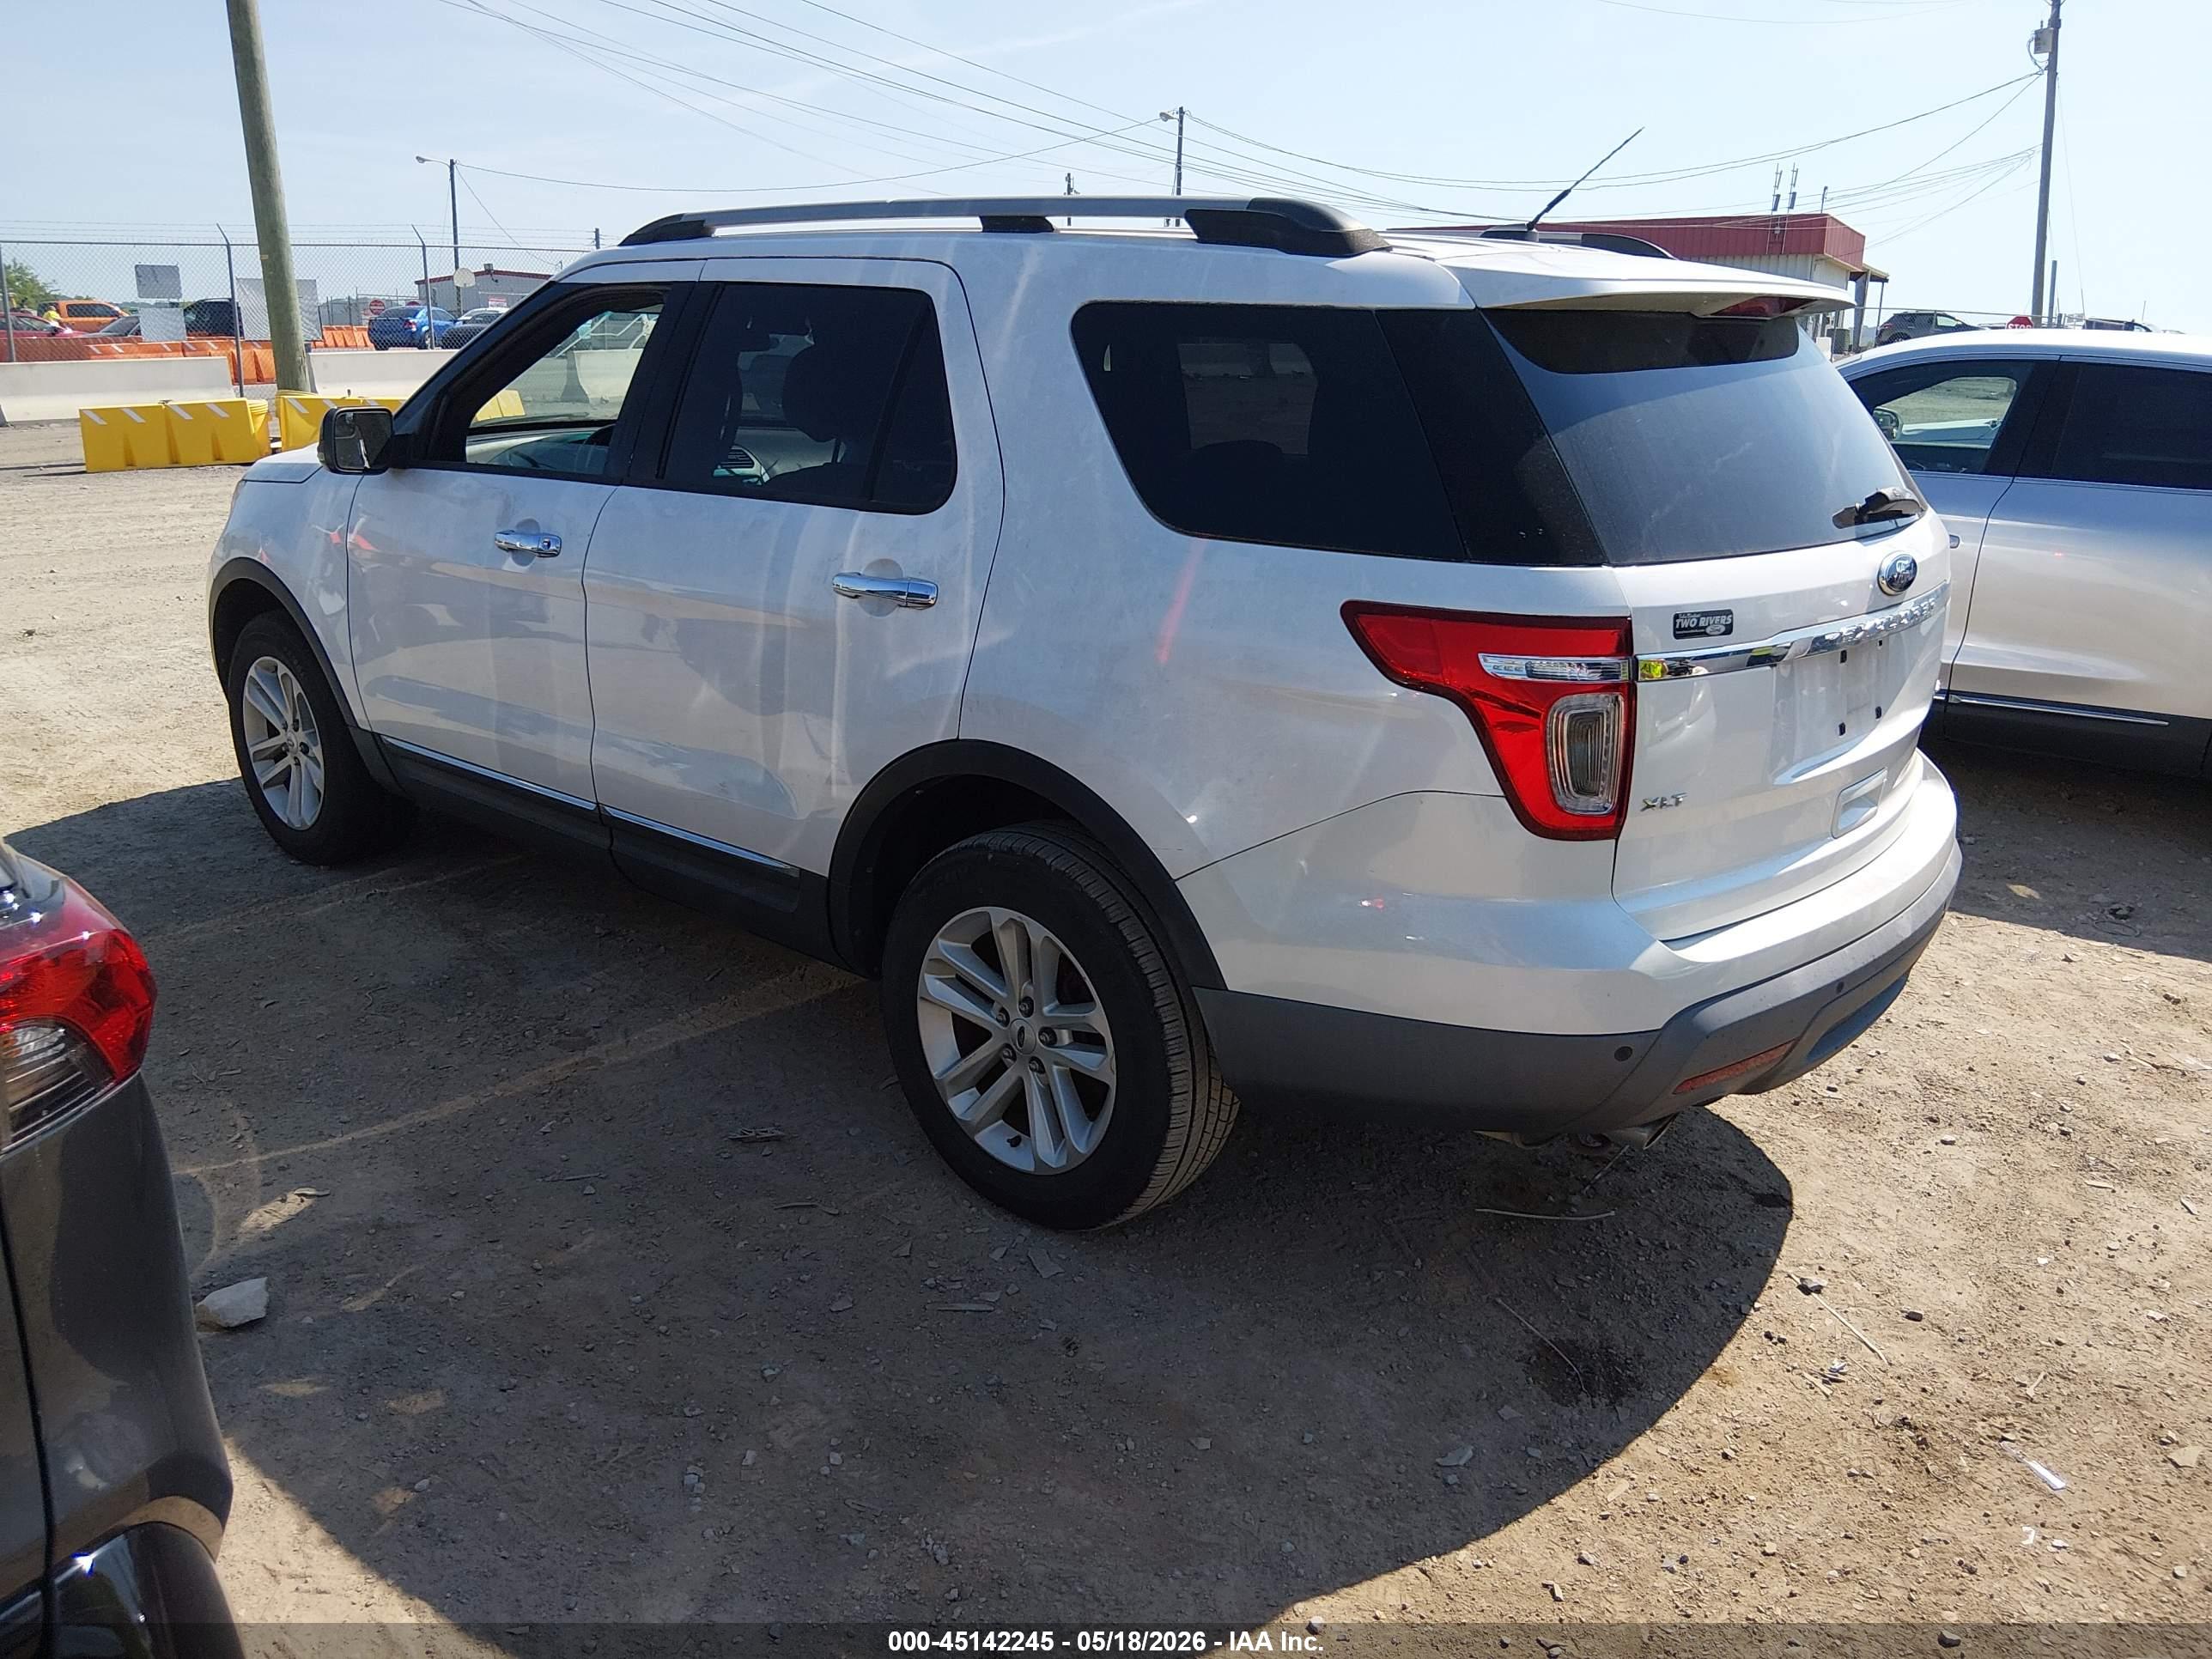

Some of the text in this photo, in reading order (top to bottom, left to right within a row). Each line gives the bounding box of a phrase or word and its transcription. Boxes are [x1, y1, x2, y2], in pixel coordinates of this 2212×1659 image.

[1675, 617, 1698, 629] TWO
[1698, 614, 1732, 627] RIVERS
[1639, 792, 1686, 812] XLT
